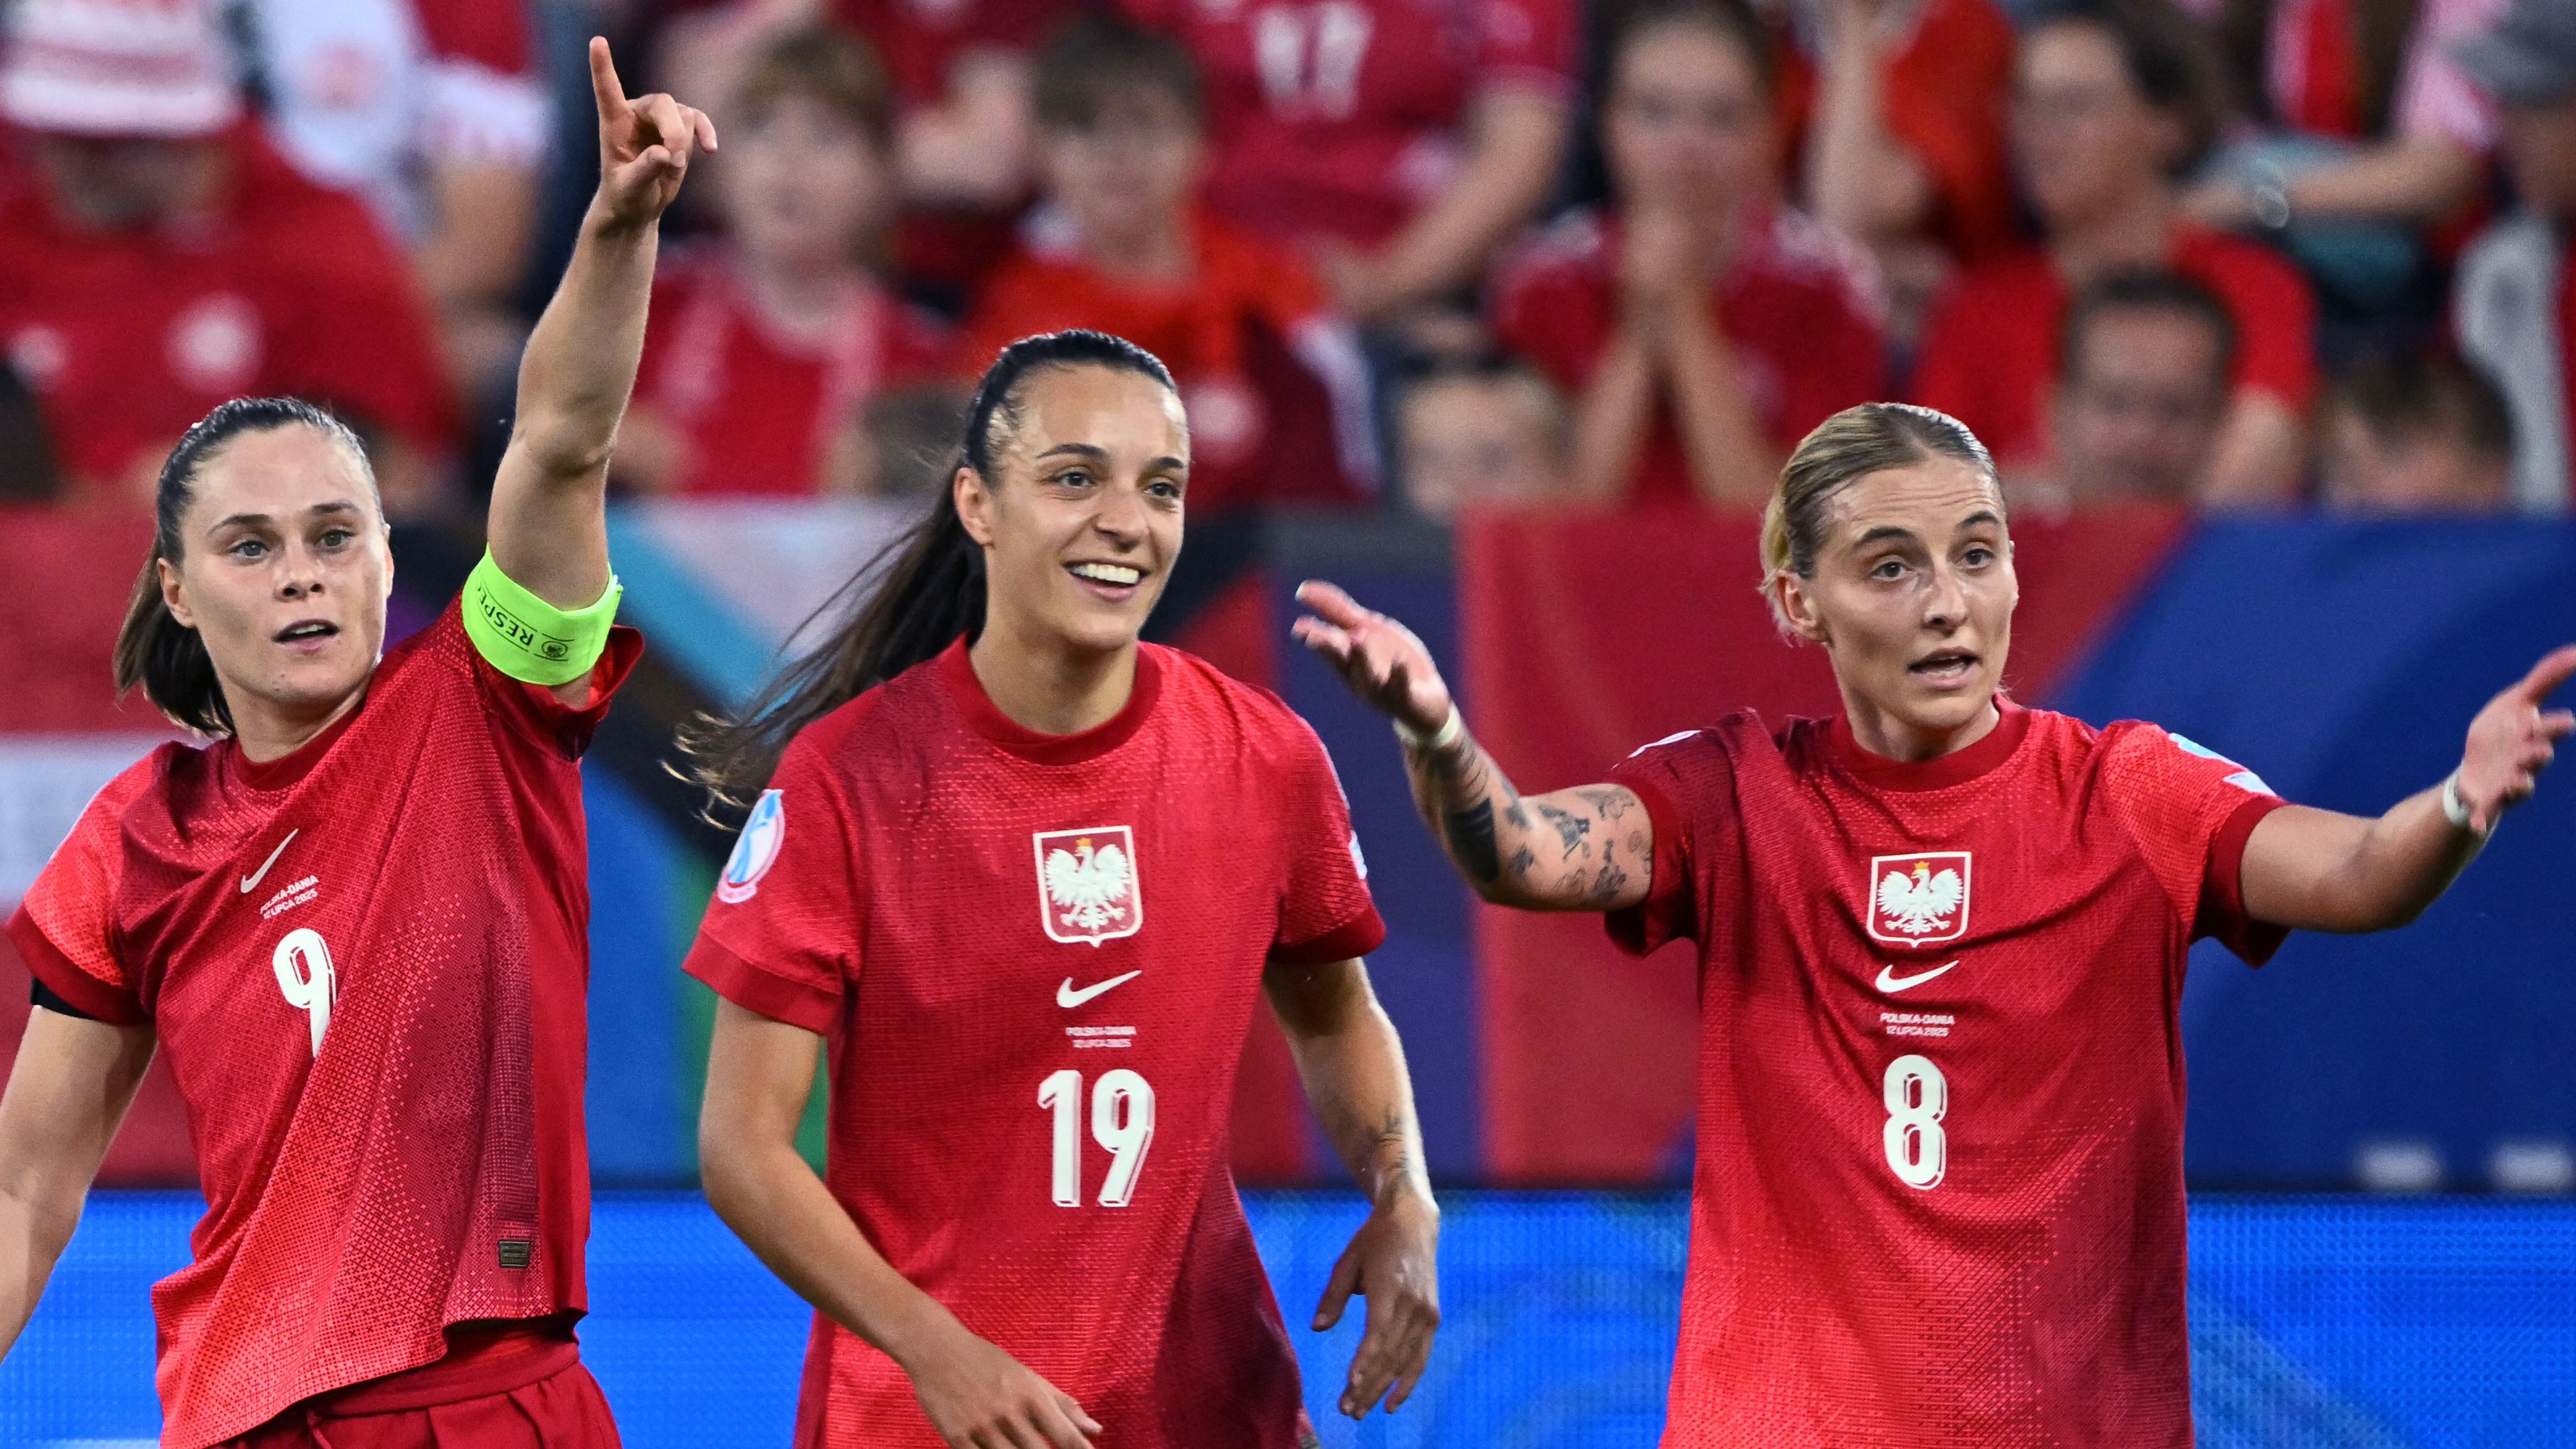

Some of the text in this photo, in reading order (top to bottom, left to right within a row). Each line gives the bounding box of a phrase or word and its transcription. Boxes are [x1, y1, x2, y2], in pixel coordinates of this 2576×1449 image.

[273, 928, 337, 1059] 9
[1037, 1068, 1156, 1208] 19
[1883, 1054, 1948, 1190] 8
